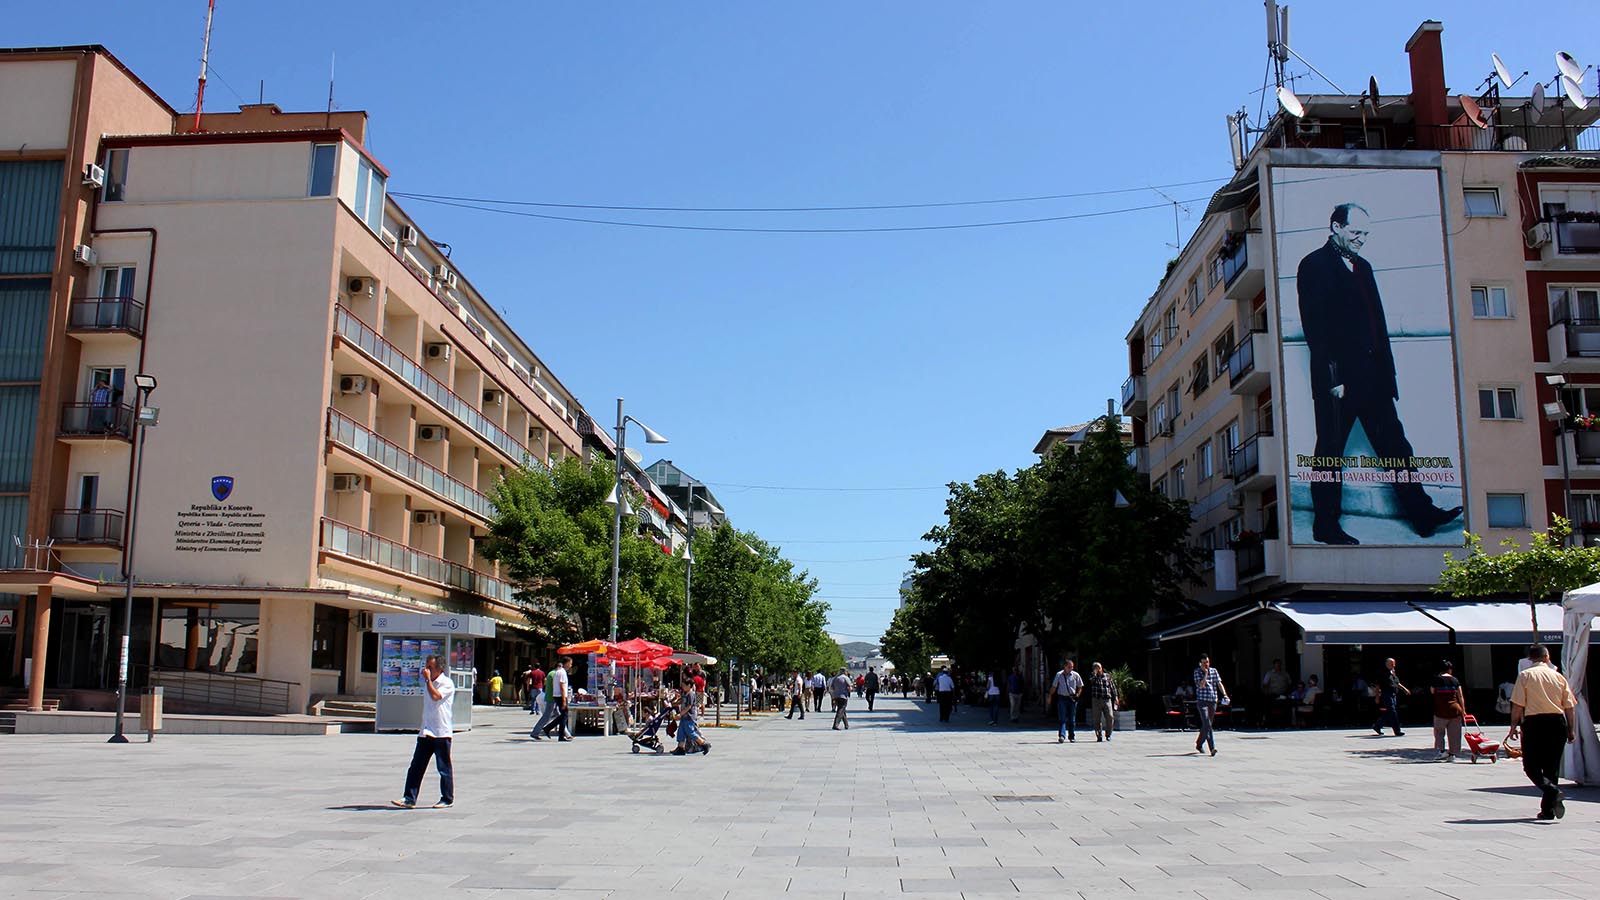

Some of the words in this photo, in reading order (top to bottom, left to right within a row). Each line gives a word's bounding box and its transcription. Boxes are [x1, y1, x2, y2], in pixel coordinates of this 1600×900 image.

[1297, 454, 1358, 467] PRESIDENTI
[1360, 455, 1405, 467] IBRAHIM
[1409, 456, 1453, 468] RUGOVA
[1298, 471, 1334, 482] SIMBOL
[191, 504, 222, 512] Republika
